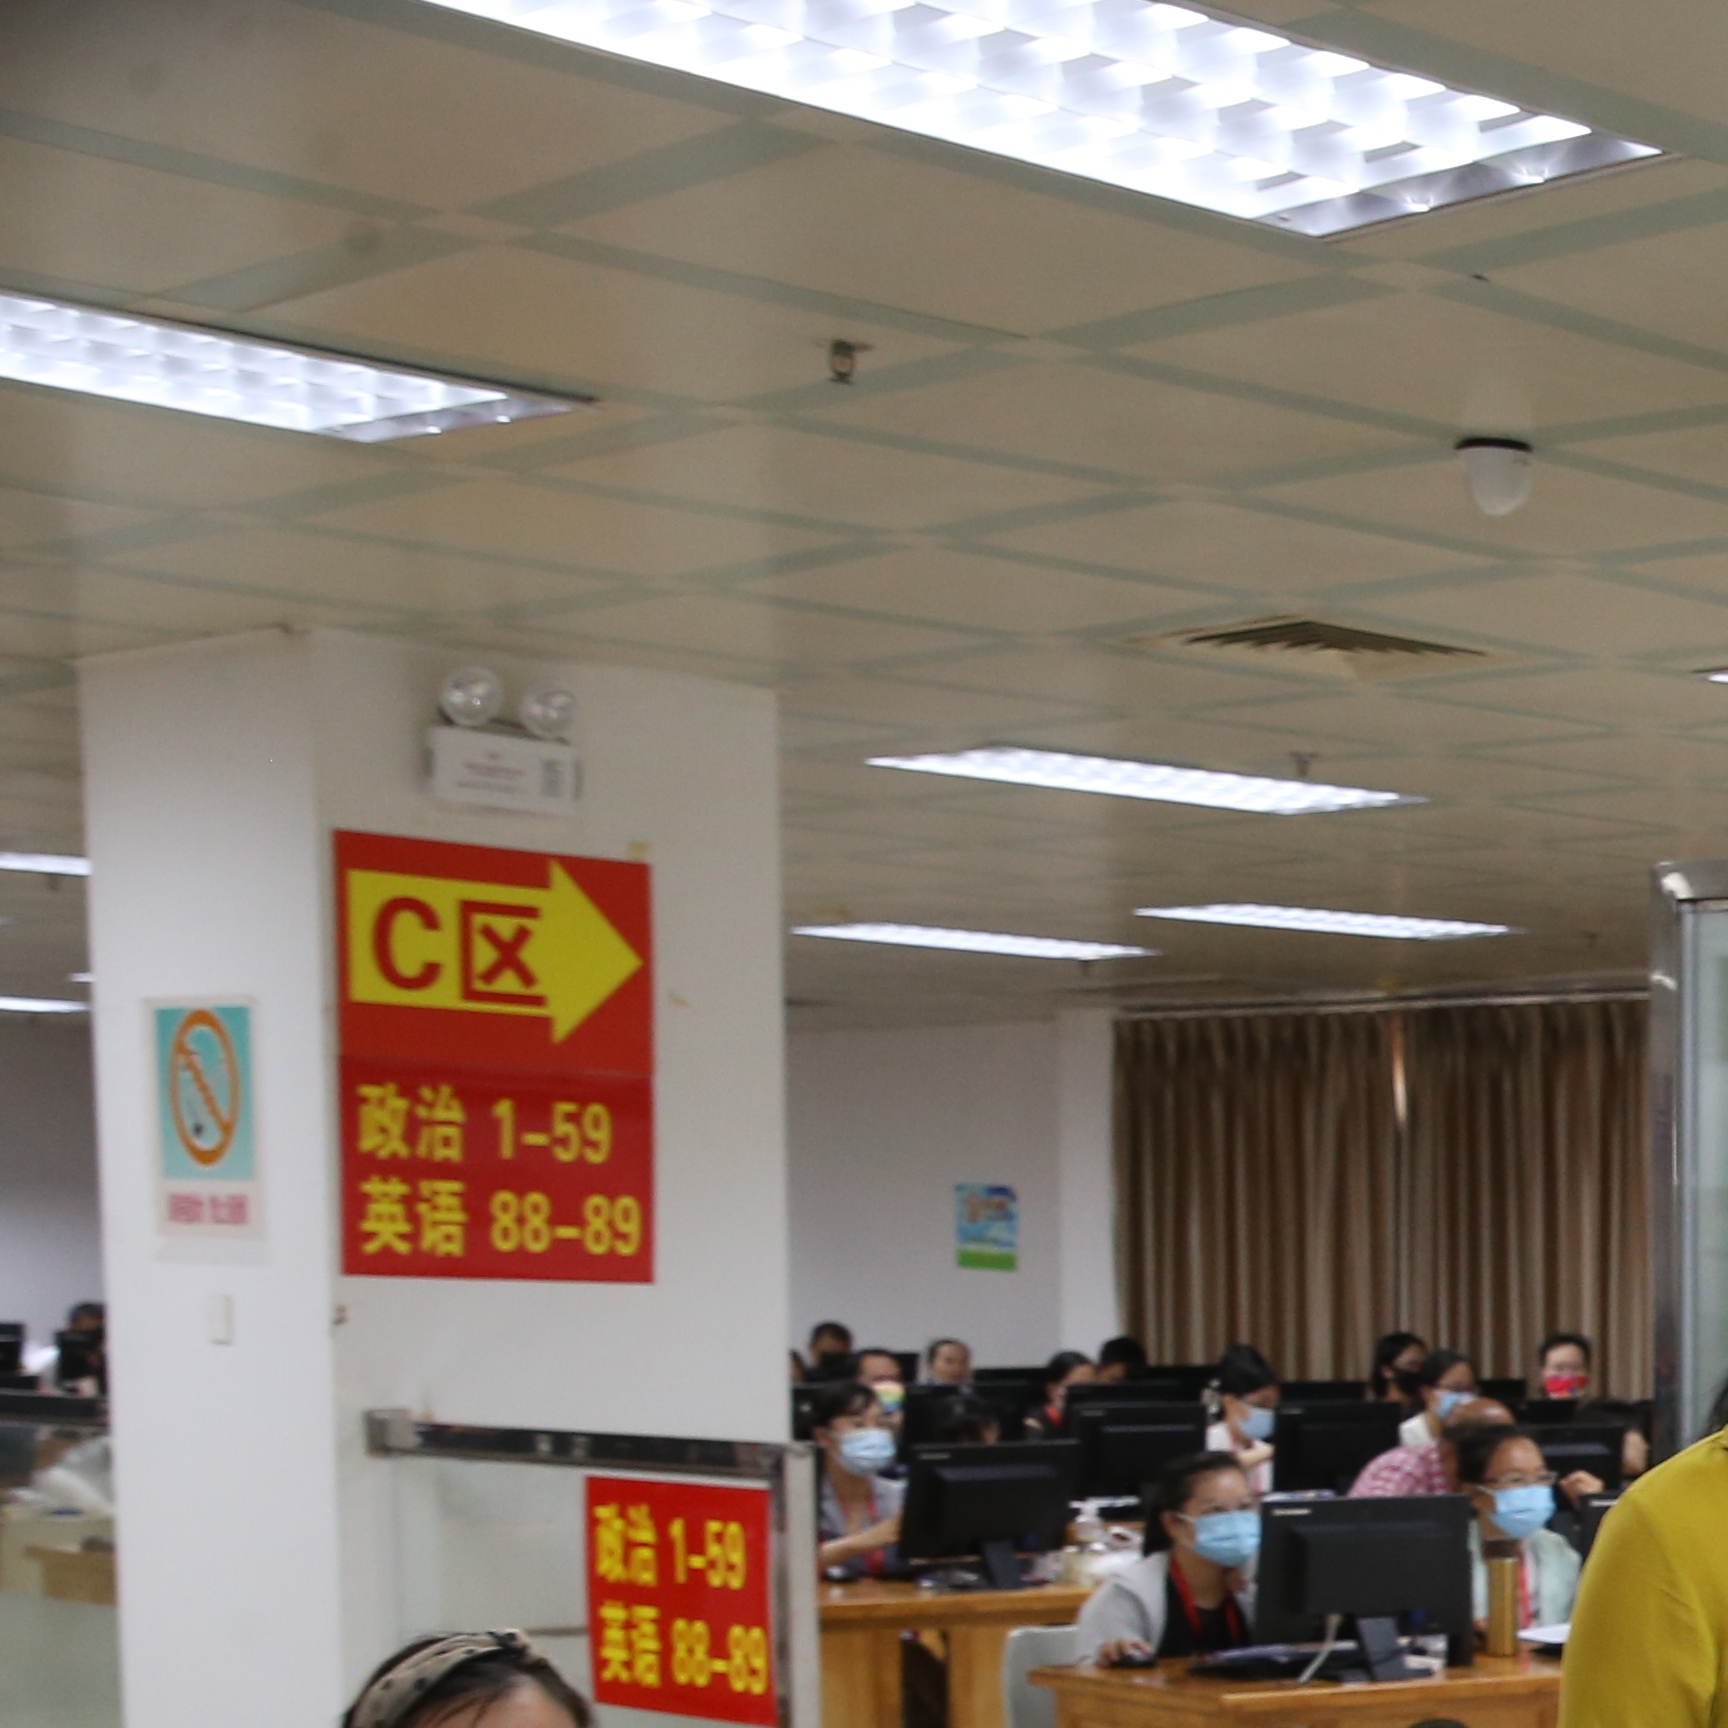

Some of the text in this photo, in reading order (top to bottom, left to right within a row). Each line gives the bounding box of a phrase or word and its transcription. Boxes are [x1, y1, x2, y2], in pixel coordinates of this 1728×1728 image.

[373, 896, 546, 1007] C区
[356, 1085, 611, 1165] 政治 1-59
[359, 1178, 641, 1258] 英语 88-89
[593, 1503, 745, 1590] 政治 1-59
[600, 1599, 769, 1696] 英语 88-89
